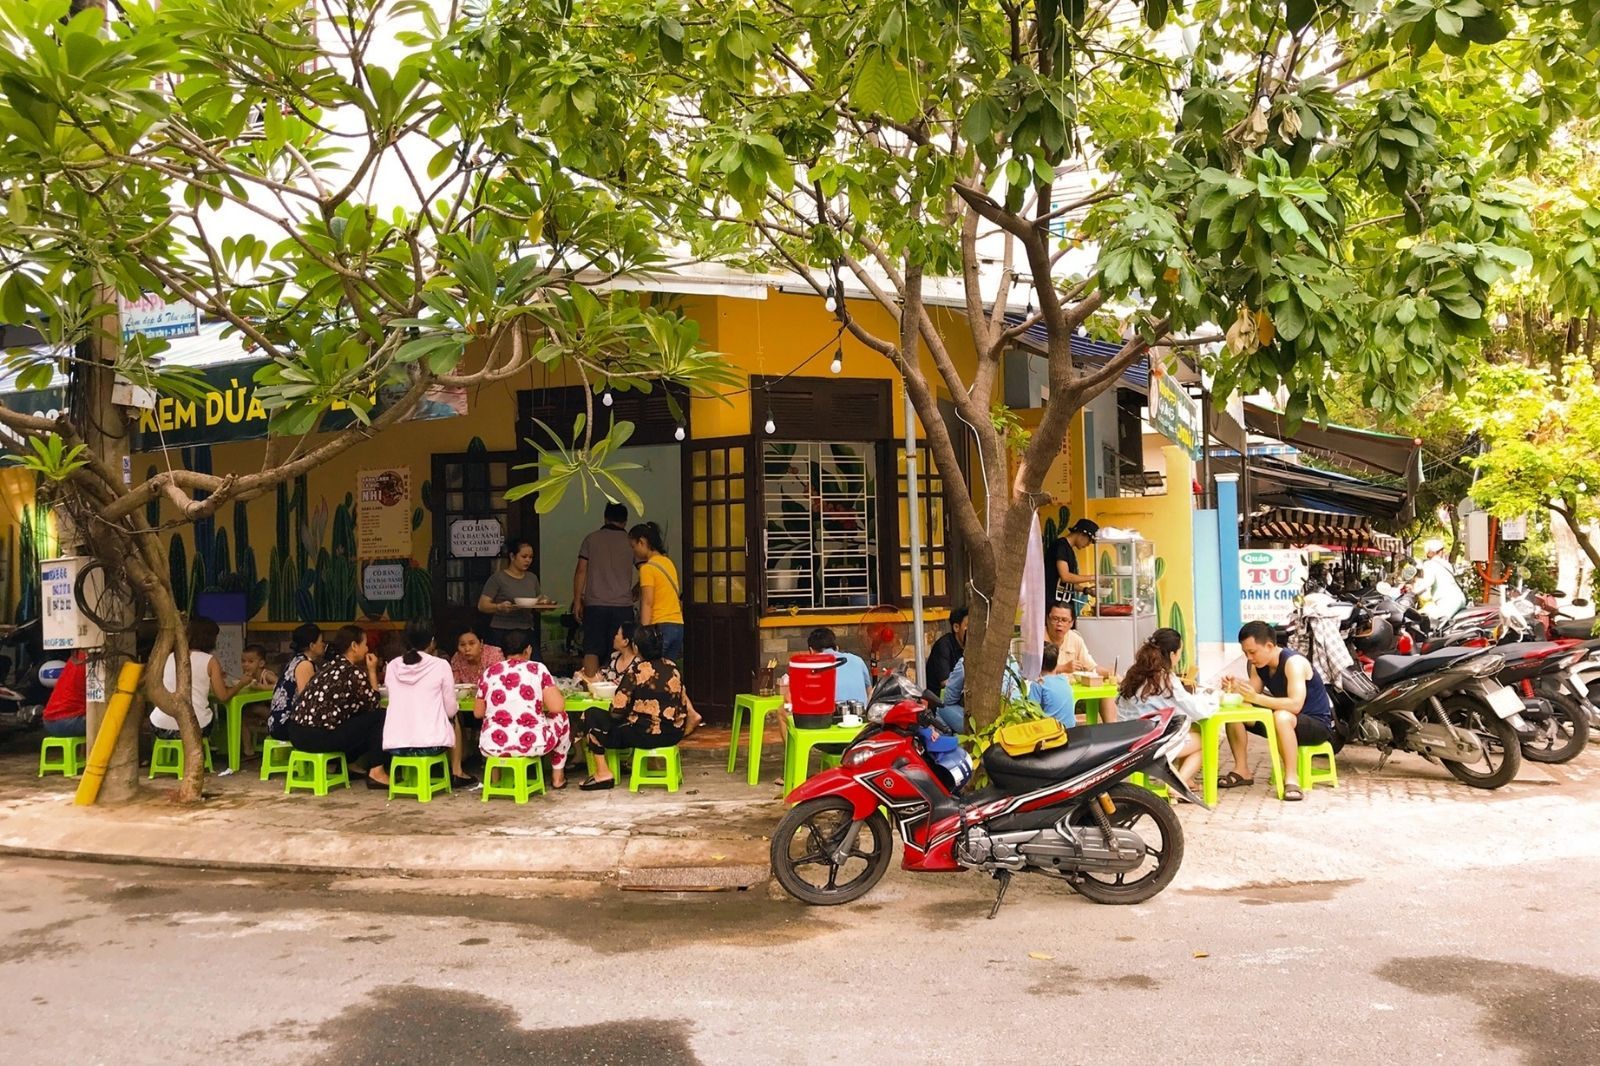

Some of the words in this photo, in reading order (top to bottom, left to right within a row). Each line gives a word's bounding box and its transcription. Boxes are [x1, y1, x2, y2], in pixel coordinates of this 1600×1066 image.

[140, 397, 197, 434] KEM
[206, 378, 267, 426] DỪA
[1244, 553, 1270, 563] Quán
[1247, 564, 1295, 585] TƯ
[1240, 586, 1270, 600] BÁNH
